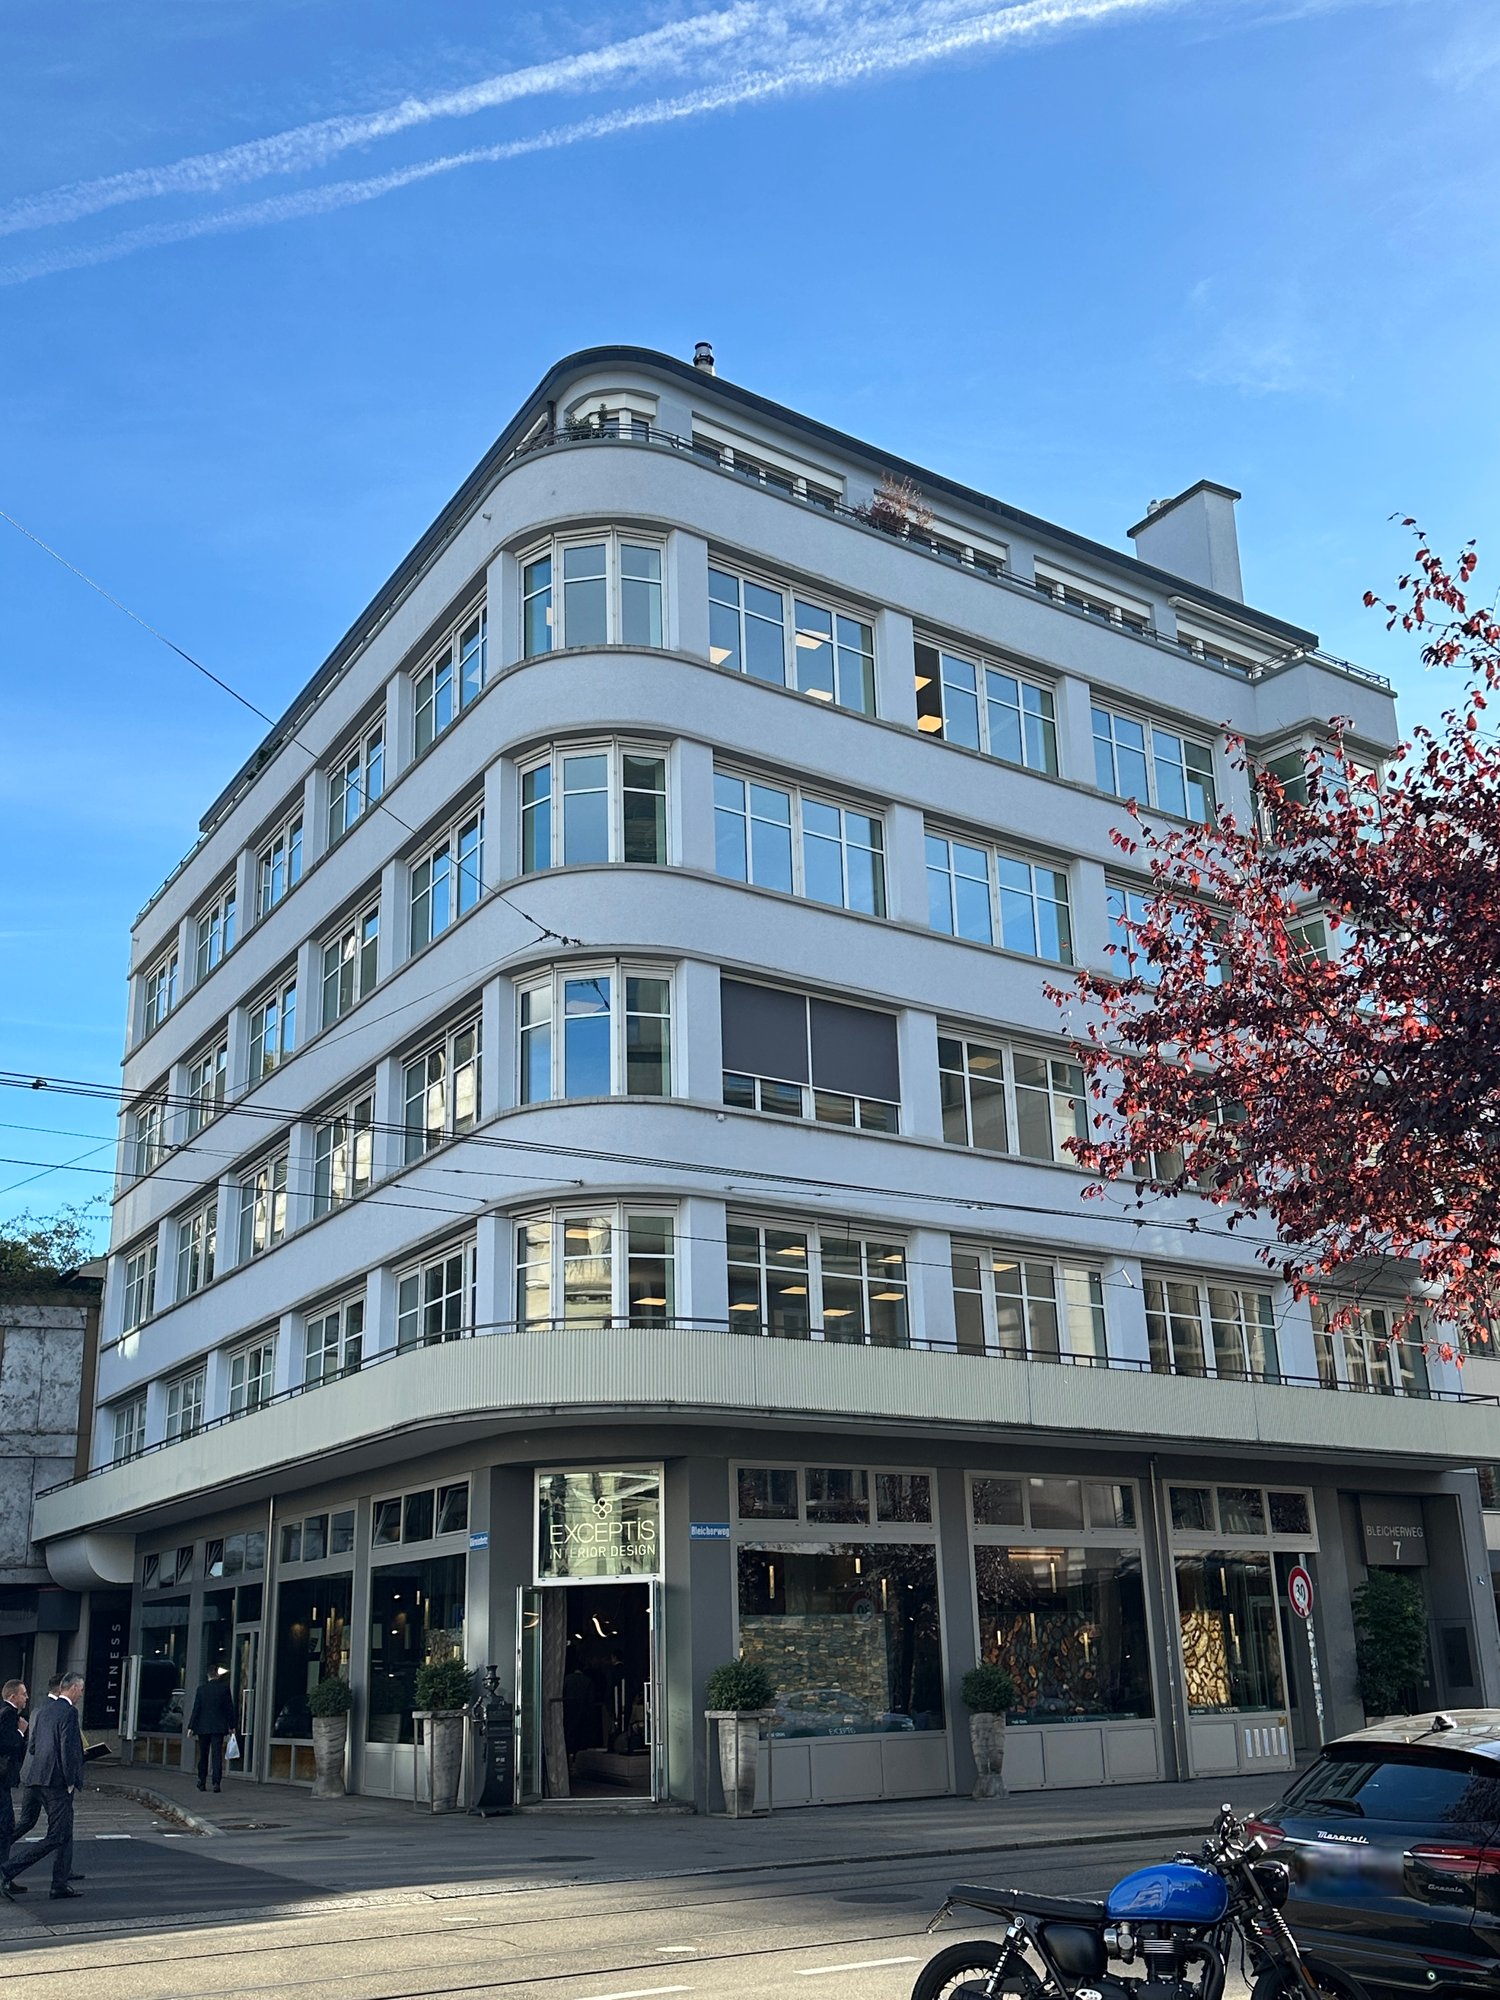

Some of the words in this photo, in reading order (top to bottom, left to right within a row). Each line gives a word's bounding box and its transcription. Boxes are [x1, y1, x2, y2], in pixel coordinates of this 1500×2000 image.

[691, 1526, 729, 1537] Bleicherweg
[1366, 1525, 1424, 1538] BLEICHERWEG
[611, 1544, 655, 1557] DESIGN
[1393, 1541, 1401, 1560] 7
[106, 1624, 121, 1712] FITNESS
[1317, 1830, 1369, 1844] Maserati
